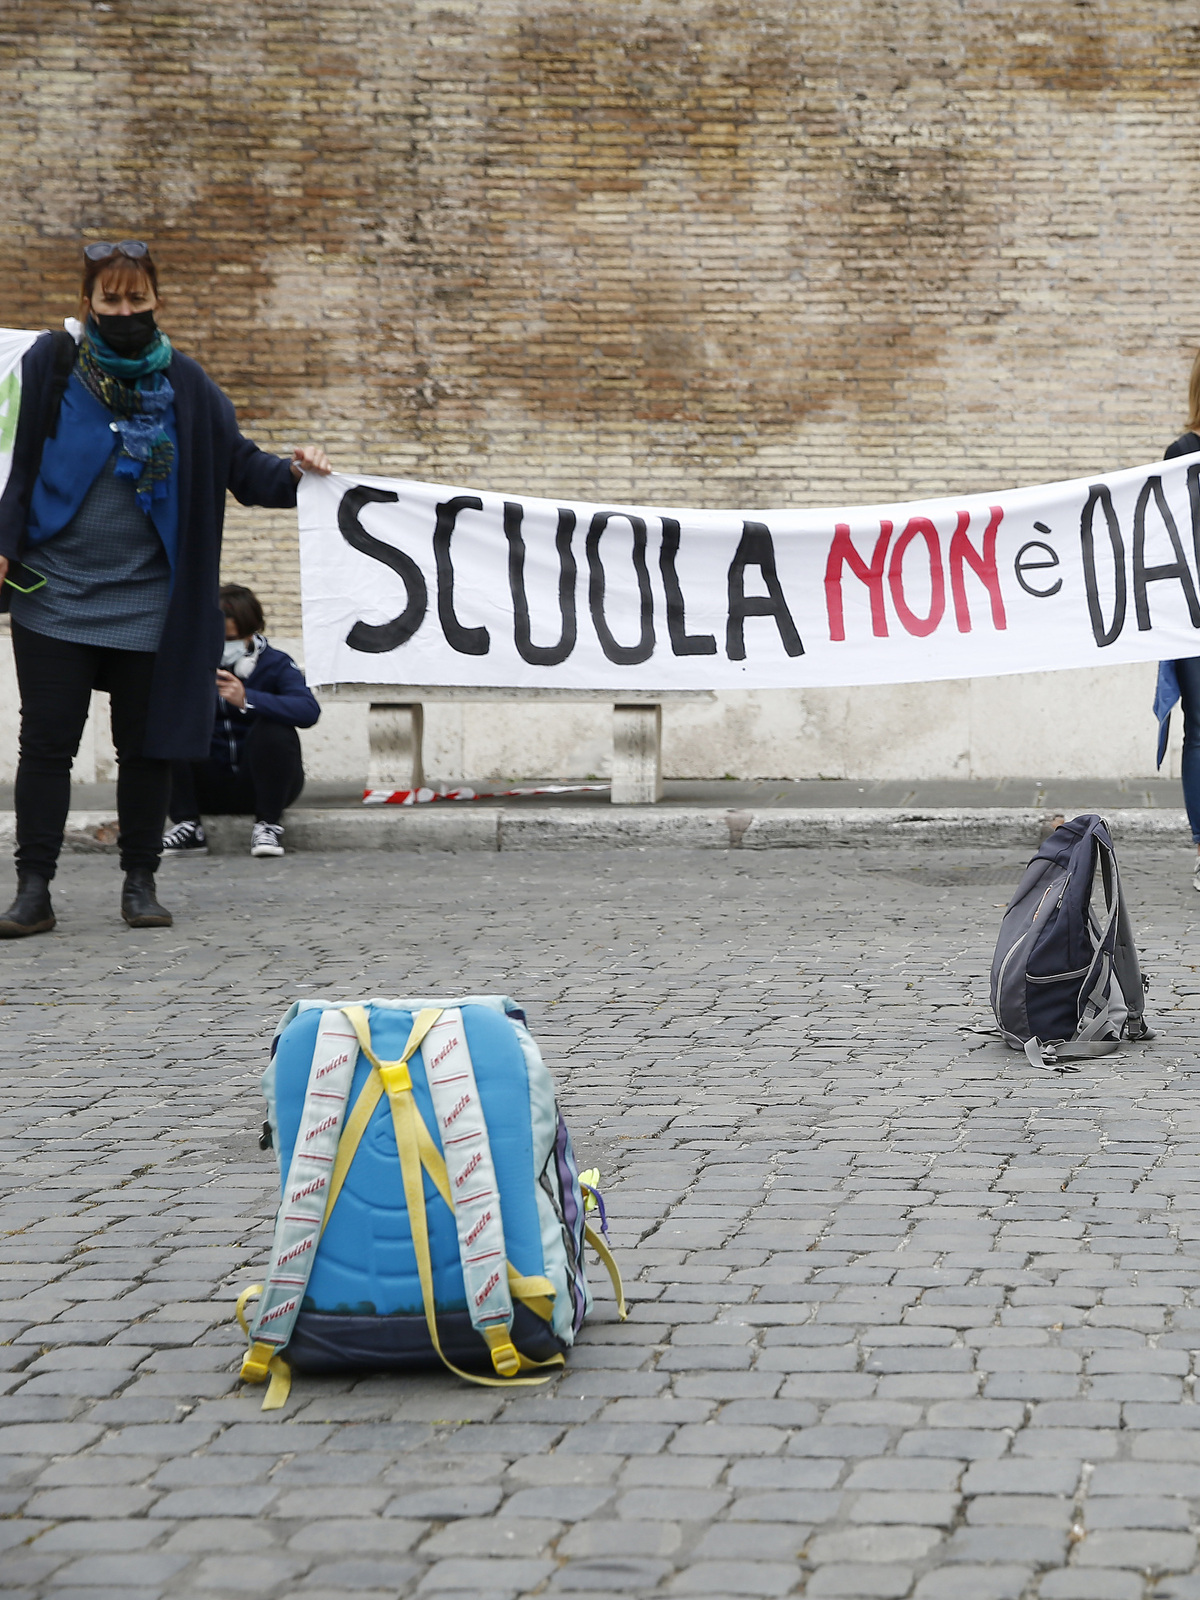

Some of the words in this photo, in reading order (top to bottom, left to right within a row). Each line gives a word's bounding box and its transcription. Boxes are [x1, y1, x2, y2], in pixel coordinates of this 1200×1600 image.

[338, 485, 805, 665] SCUOLA
[824, 506, 1007, 641] NON
[1014, 522, 1063, 597] è
